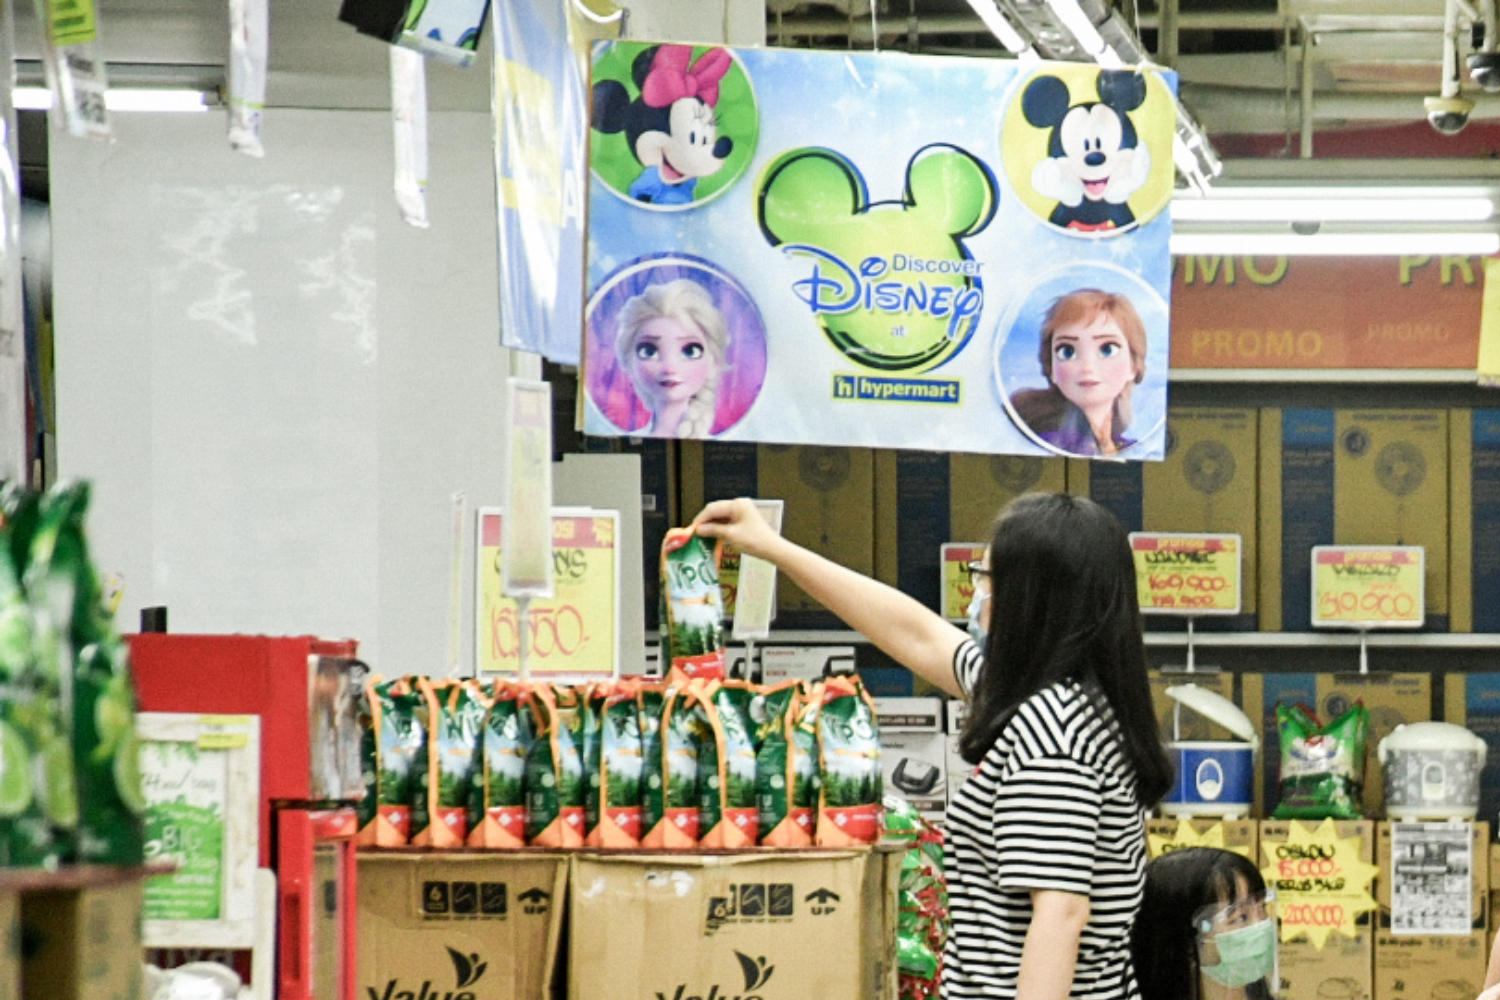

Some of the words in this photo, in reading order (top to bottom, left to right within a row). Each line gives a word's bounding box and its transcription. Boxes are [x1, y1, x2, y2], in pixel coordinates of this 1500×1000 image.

[892, 254, 983, 276] Discover
[891, 326, 907, 338] at
[1366, 322, 1450, 343] PROMO
[1191, 329, 1324, 359] PROMO
[861, 377, 957, 400] hypermart
[810, 906, 836, 916] UP
